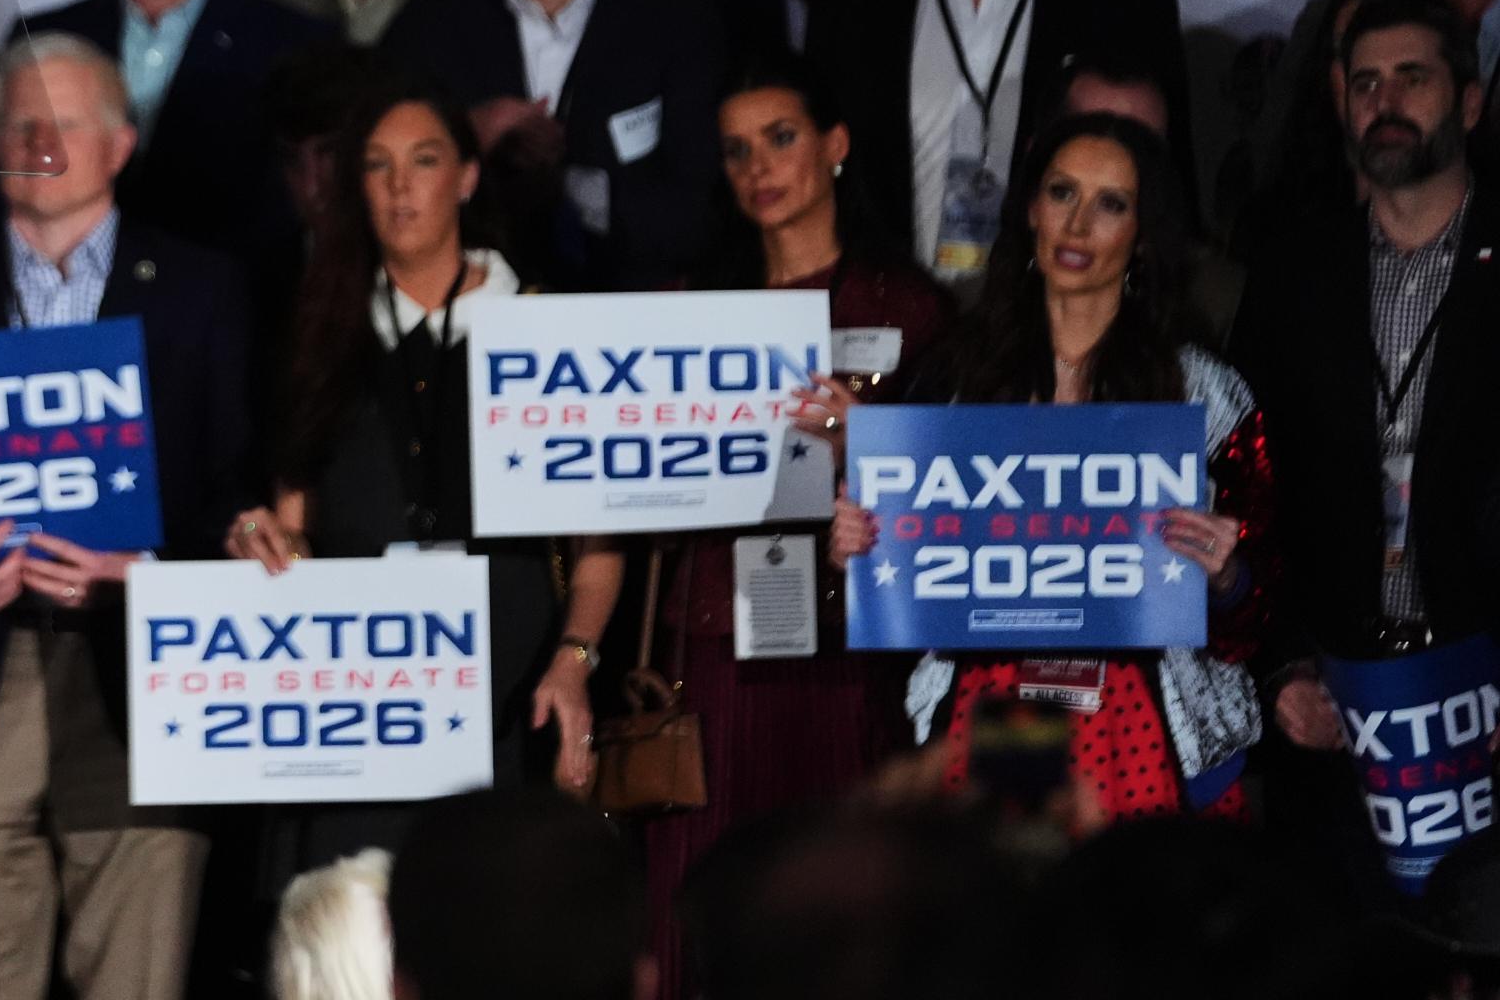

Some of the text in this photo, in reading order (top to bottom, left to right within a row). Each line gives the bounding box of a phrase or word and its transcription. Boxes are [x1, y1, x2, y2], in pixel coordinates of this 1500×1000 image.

[486, 345, 820, 396] PAXTON
[487, 399, 789, 427] FOR SENAT
[544, 432, 769, 482] 2026
[857, 452, 1198, 510] PAXTON
[874, 511, 1161, 539] OR SENAT
[913, 543, 1145, 599] 2026
[146, 610, 476, 662] PAXTON
[147, 665, 479, 693] FOR SENATE
[203, 699, 426, 749] 2026
[1367, 752, 1484, 789] SENA
[1365, 775, 1493, 847] 026
